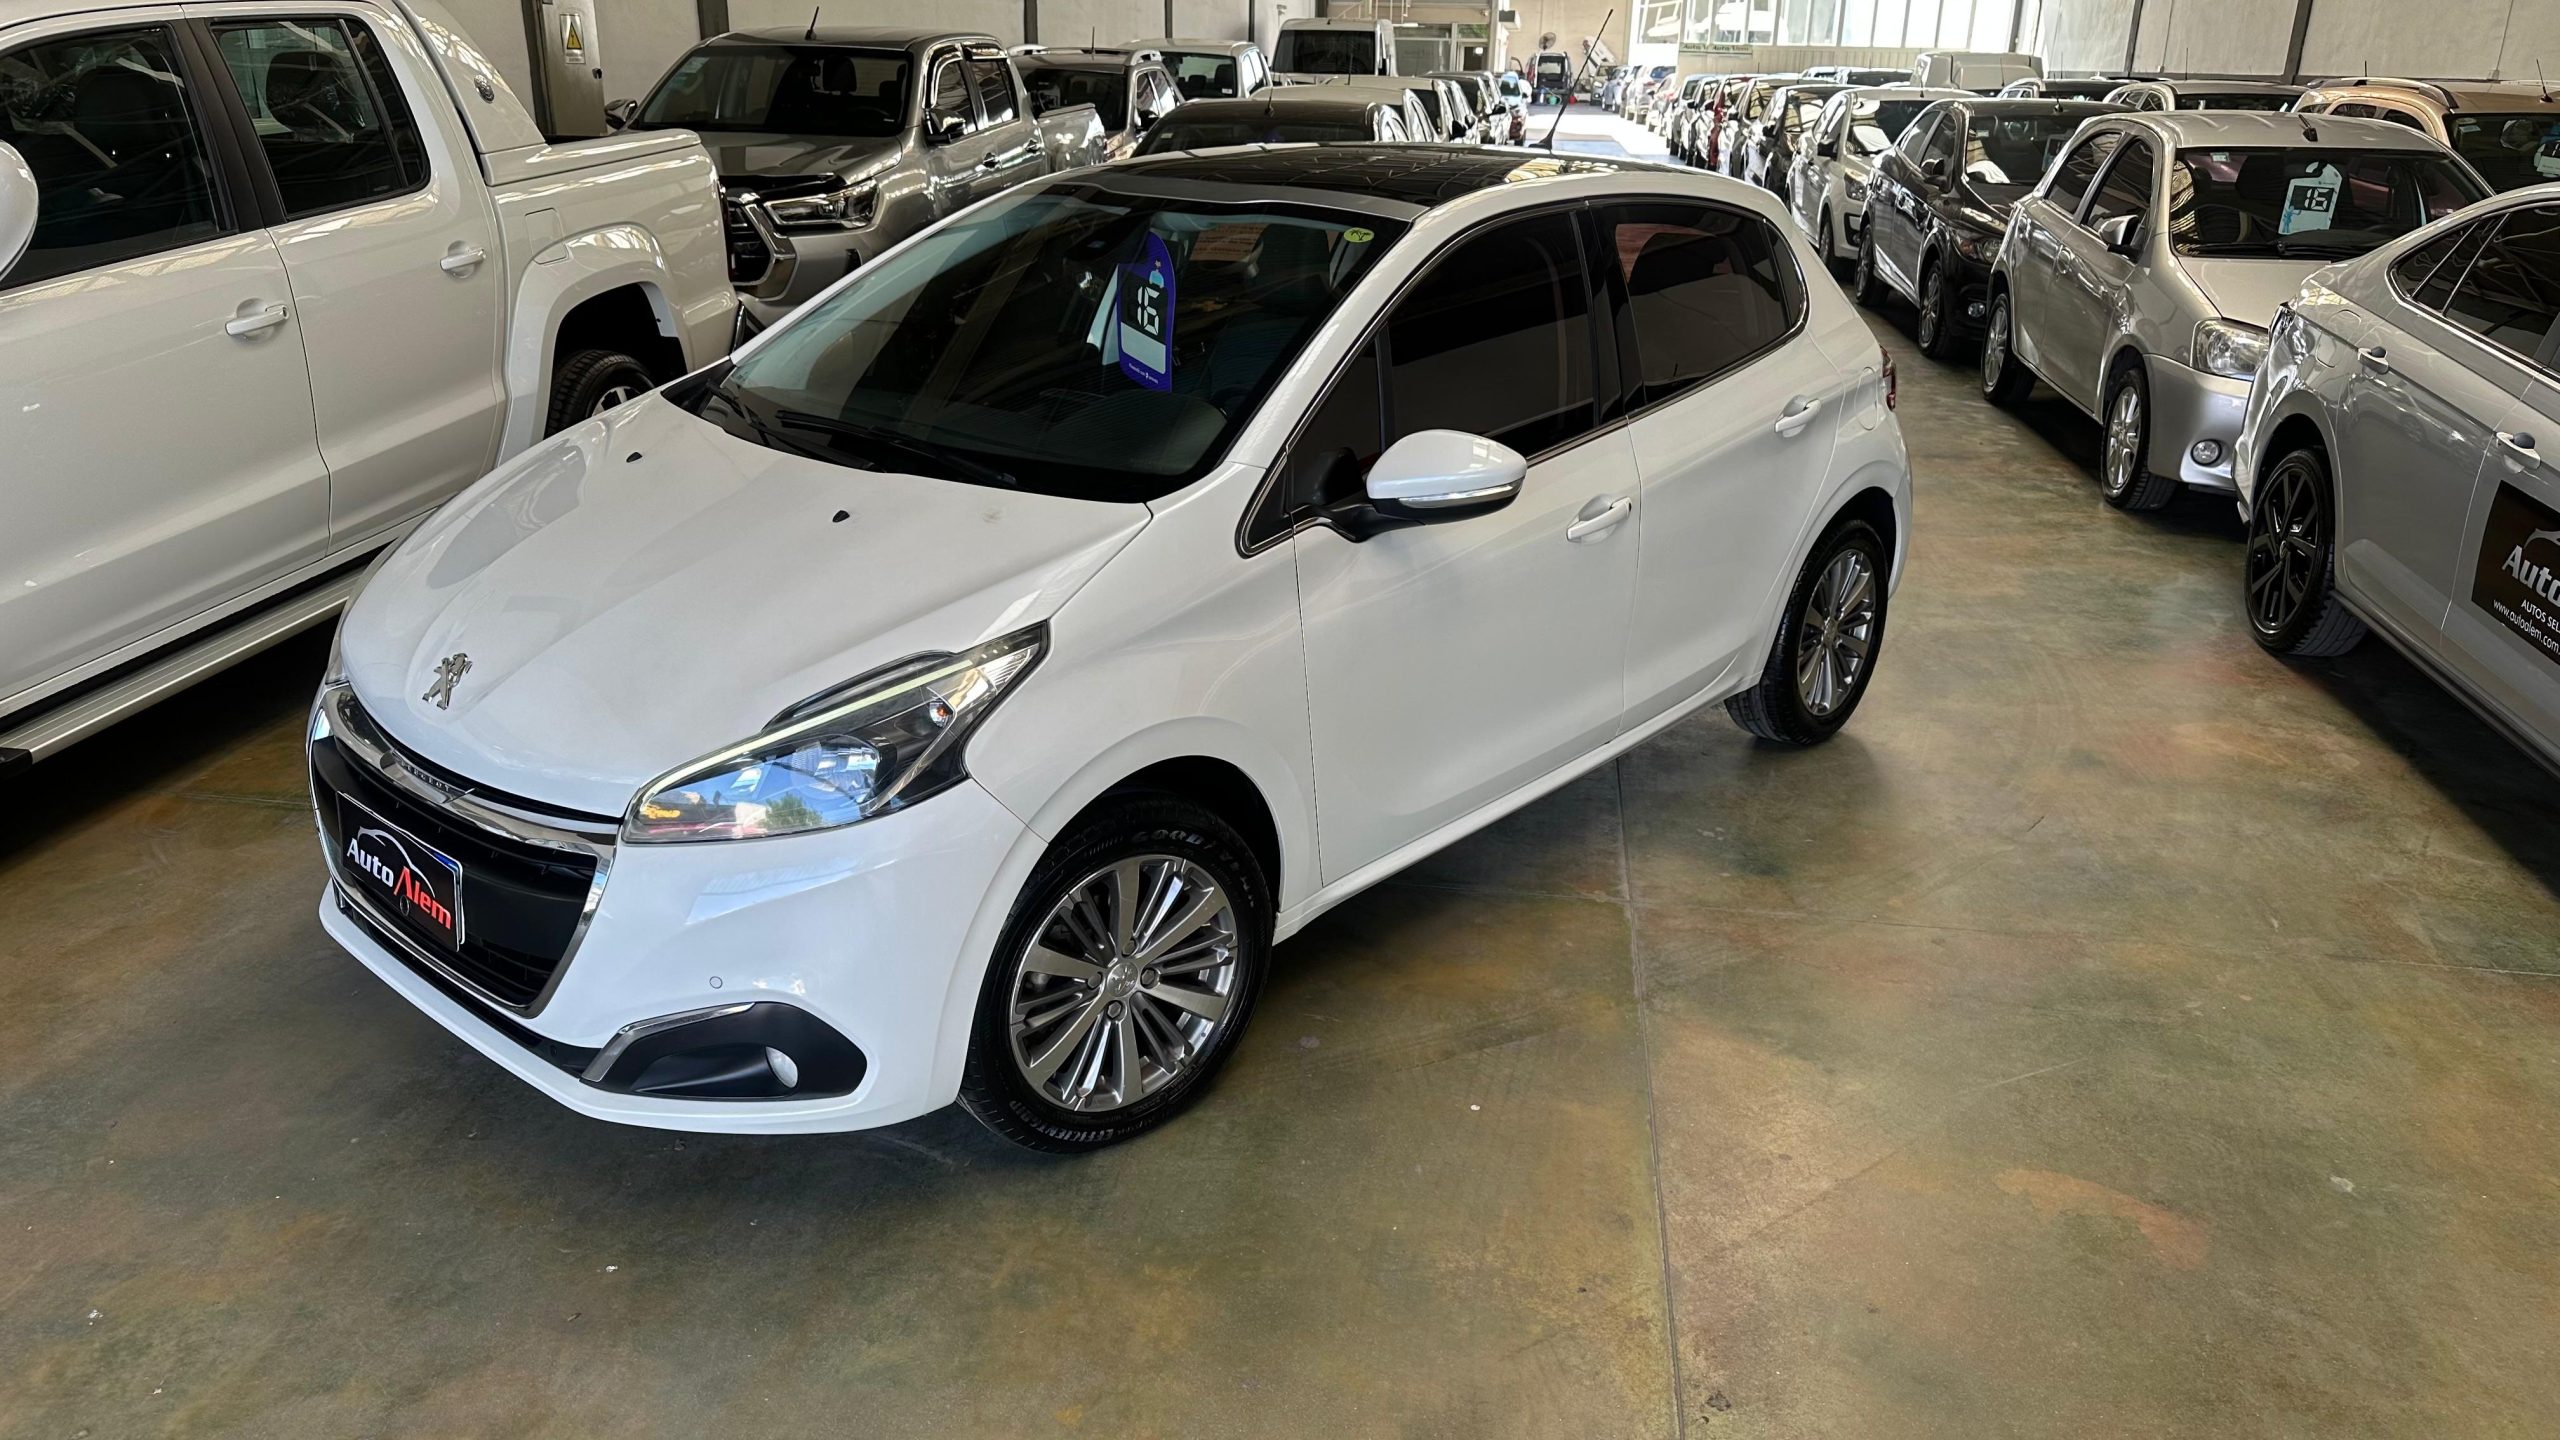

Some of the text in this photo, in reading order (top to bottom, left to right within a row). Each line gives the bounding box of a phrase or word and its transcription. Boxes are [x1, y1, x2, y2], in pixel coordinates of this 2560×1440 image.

[2304, 188, 2331, 211] 16
[1137, 285, 1161, 336] 16
[2502, 545, 2560, 608] Auto
[2521, 600, 2546, 623] AUTOS
